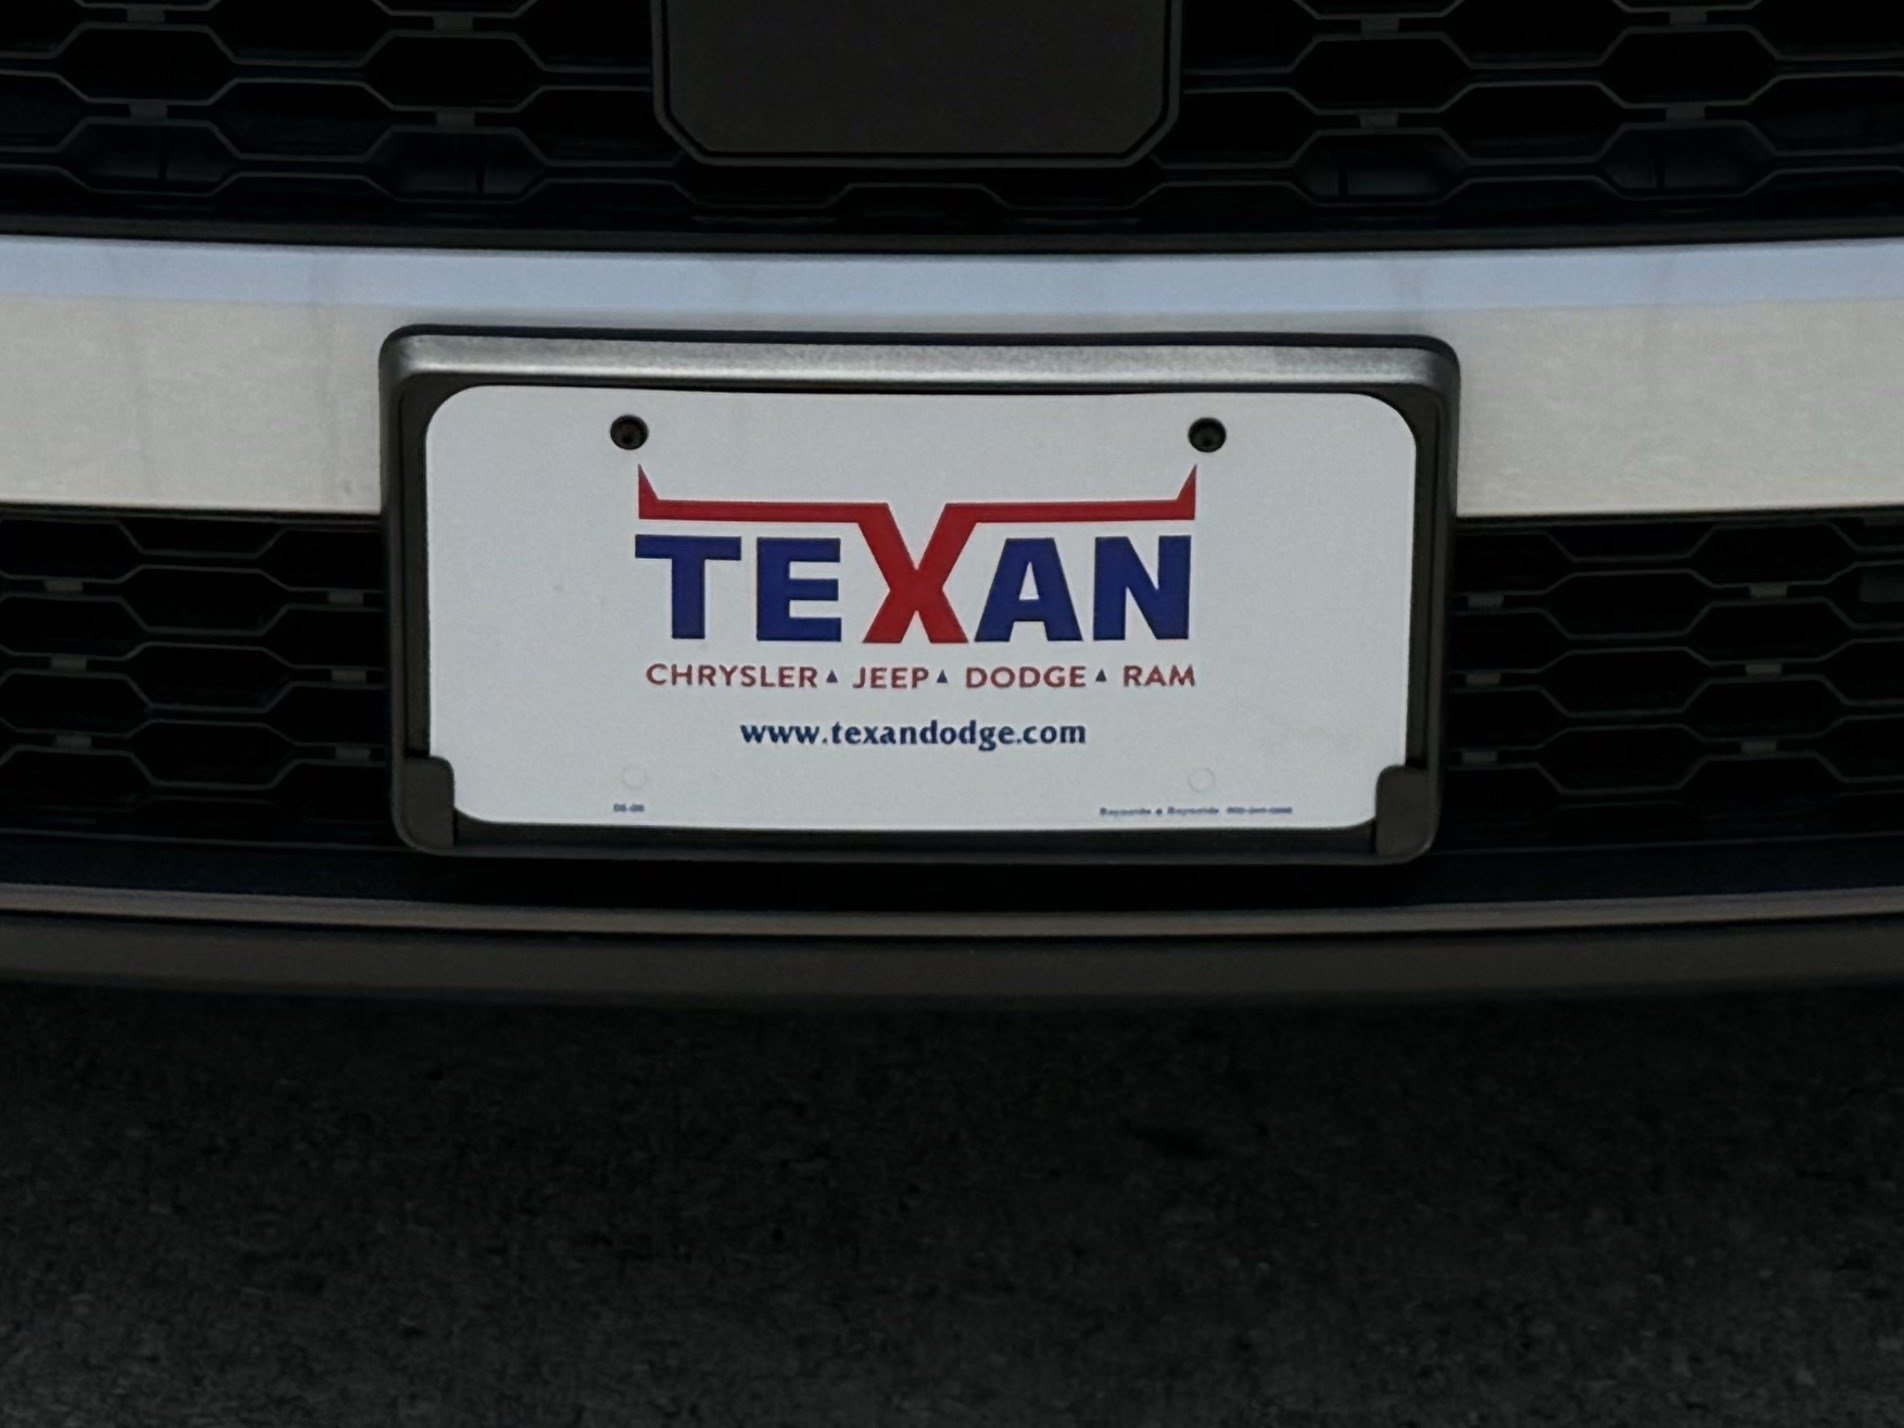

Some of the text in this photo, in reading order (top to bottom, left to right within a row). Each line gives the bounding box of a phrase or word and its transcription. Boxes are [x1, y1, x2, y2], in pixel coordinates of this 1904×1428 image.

[635, 496, 1194, 644] TEXAN
[645, 663, 1195, 689] CHRYSLER JEEP DODGE RAM
[740, 719, 1087, 752] www.texandodge.com
